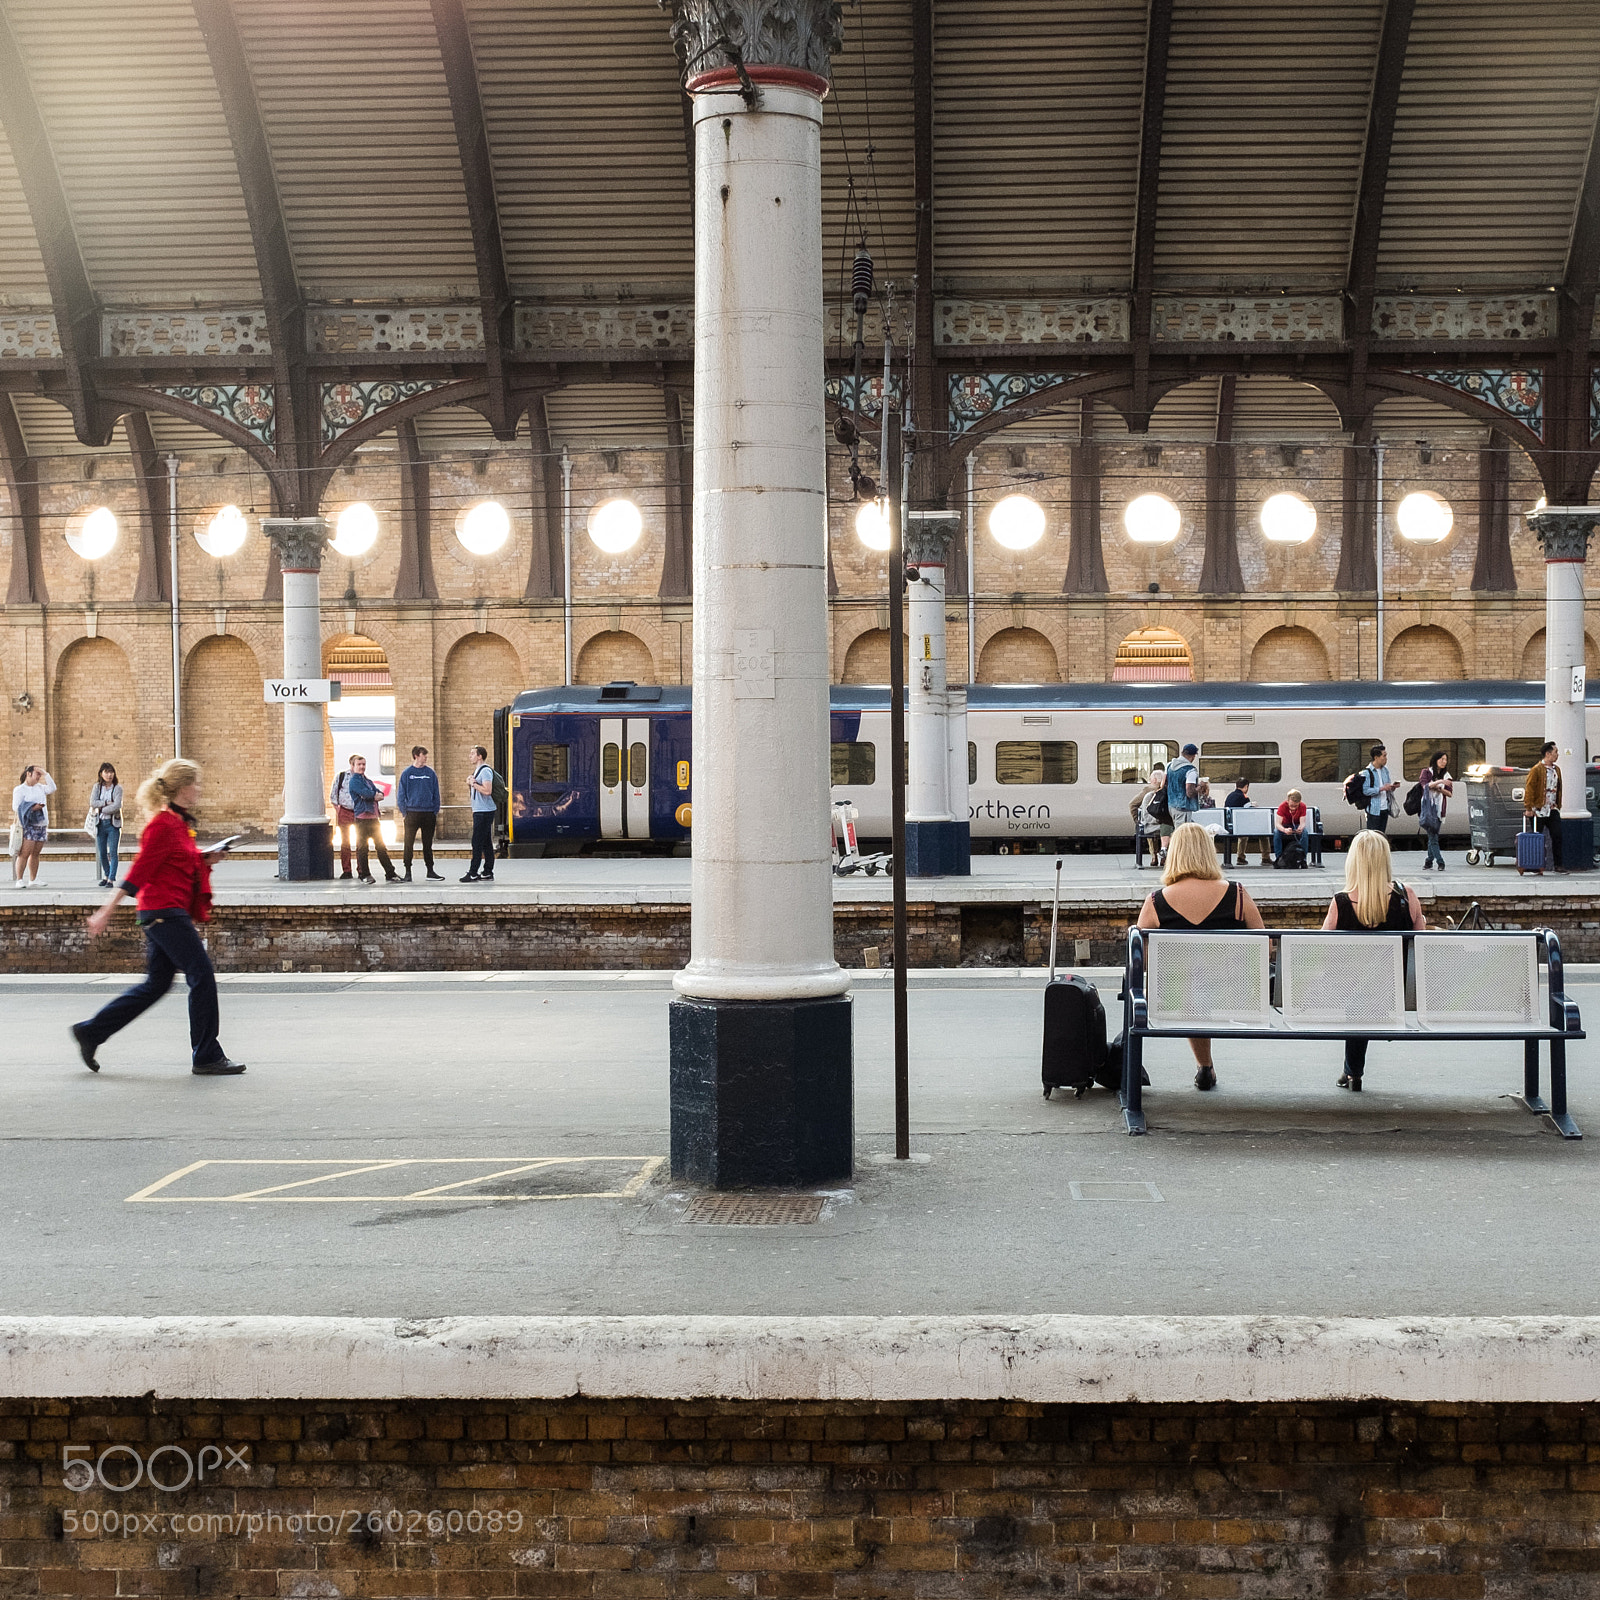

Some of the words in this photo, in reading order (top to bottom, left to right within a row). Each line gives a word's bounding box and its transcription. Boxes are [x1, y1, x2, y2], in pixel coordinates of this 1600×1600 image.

[271, 683, 308, 697] York
[1573, 675, 1583, 693] 5a
[968, 799, 1050, 819] rthern
[1008, 820, 1021, 831] by
[1022, 821, 1051, 830] arriva
